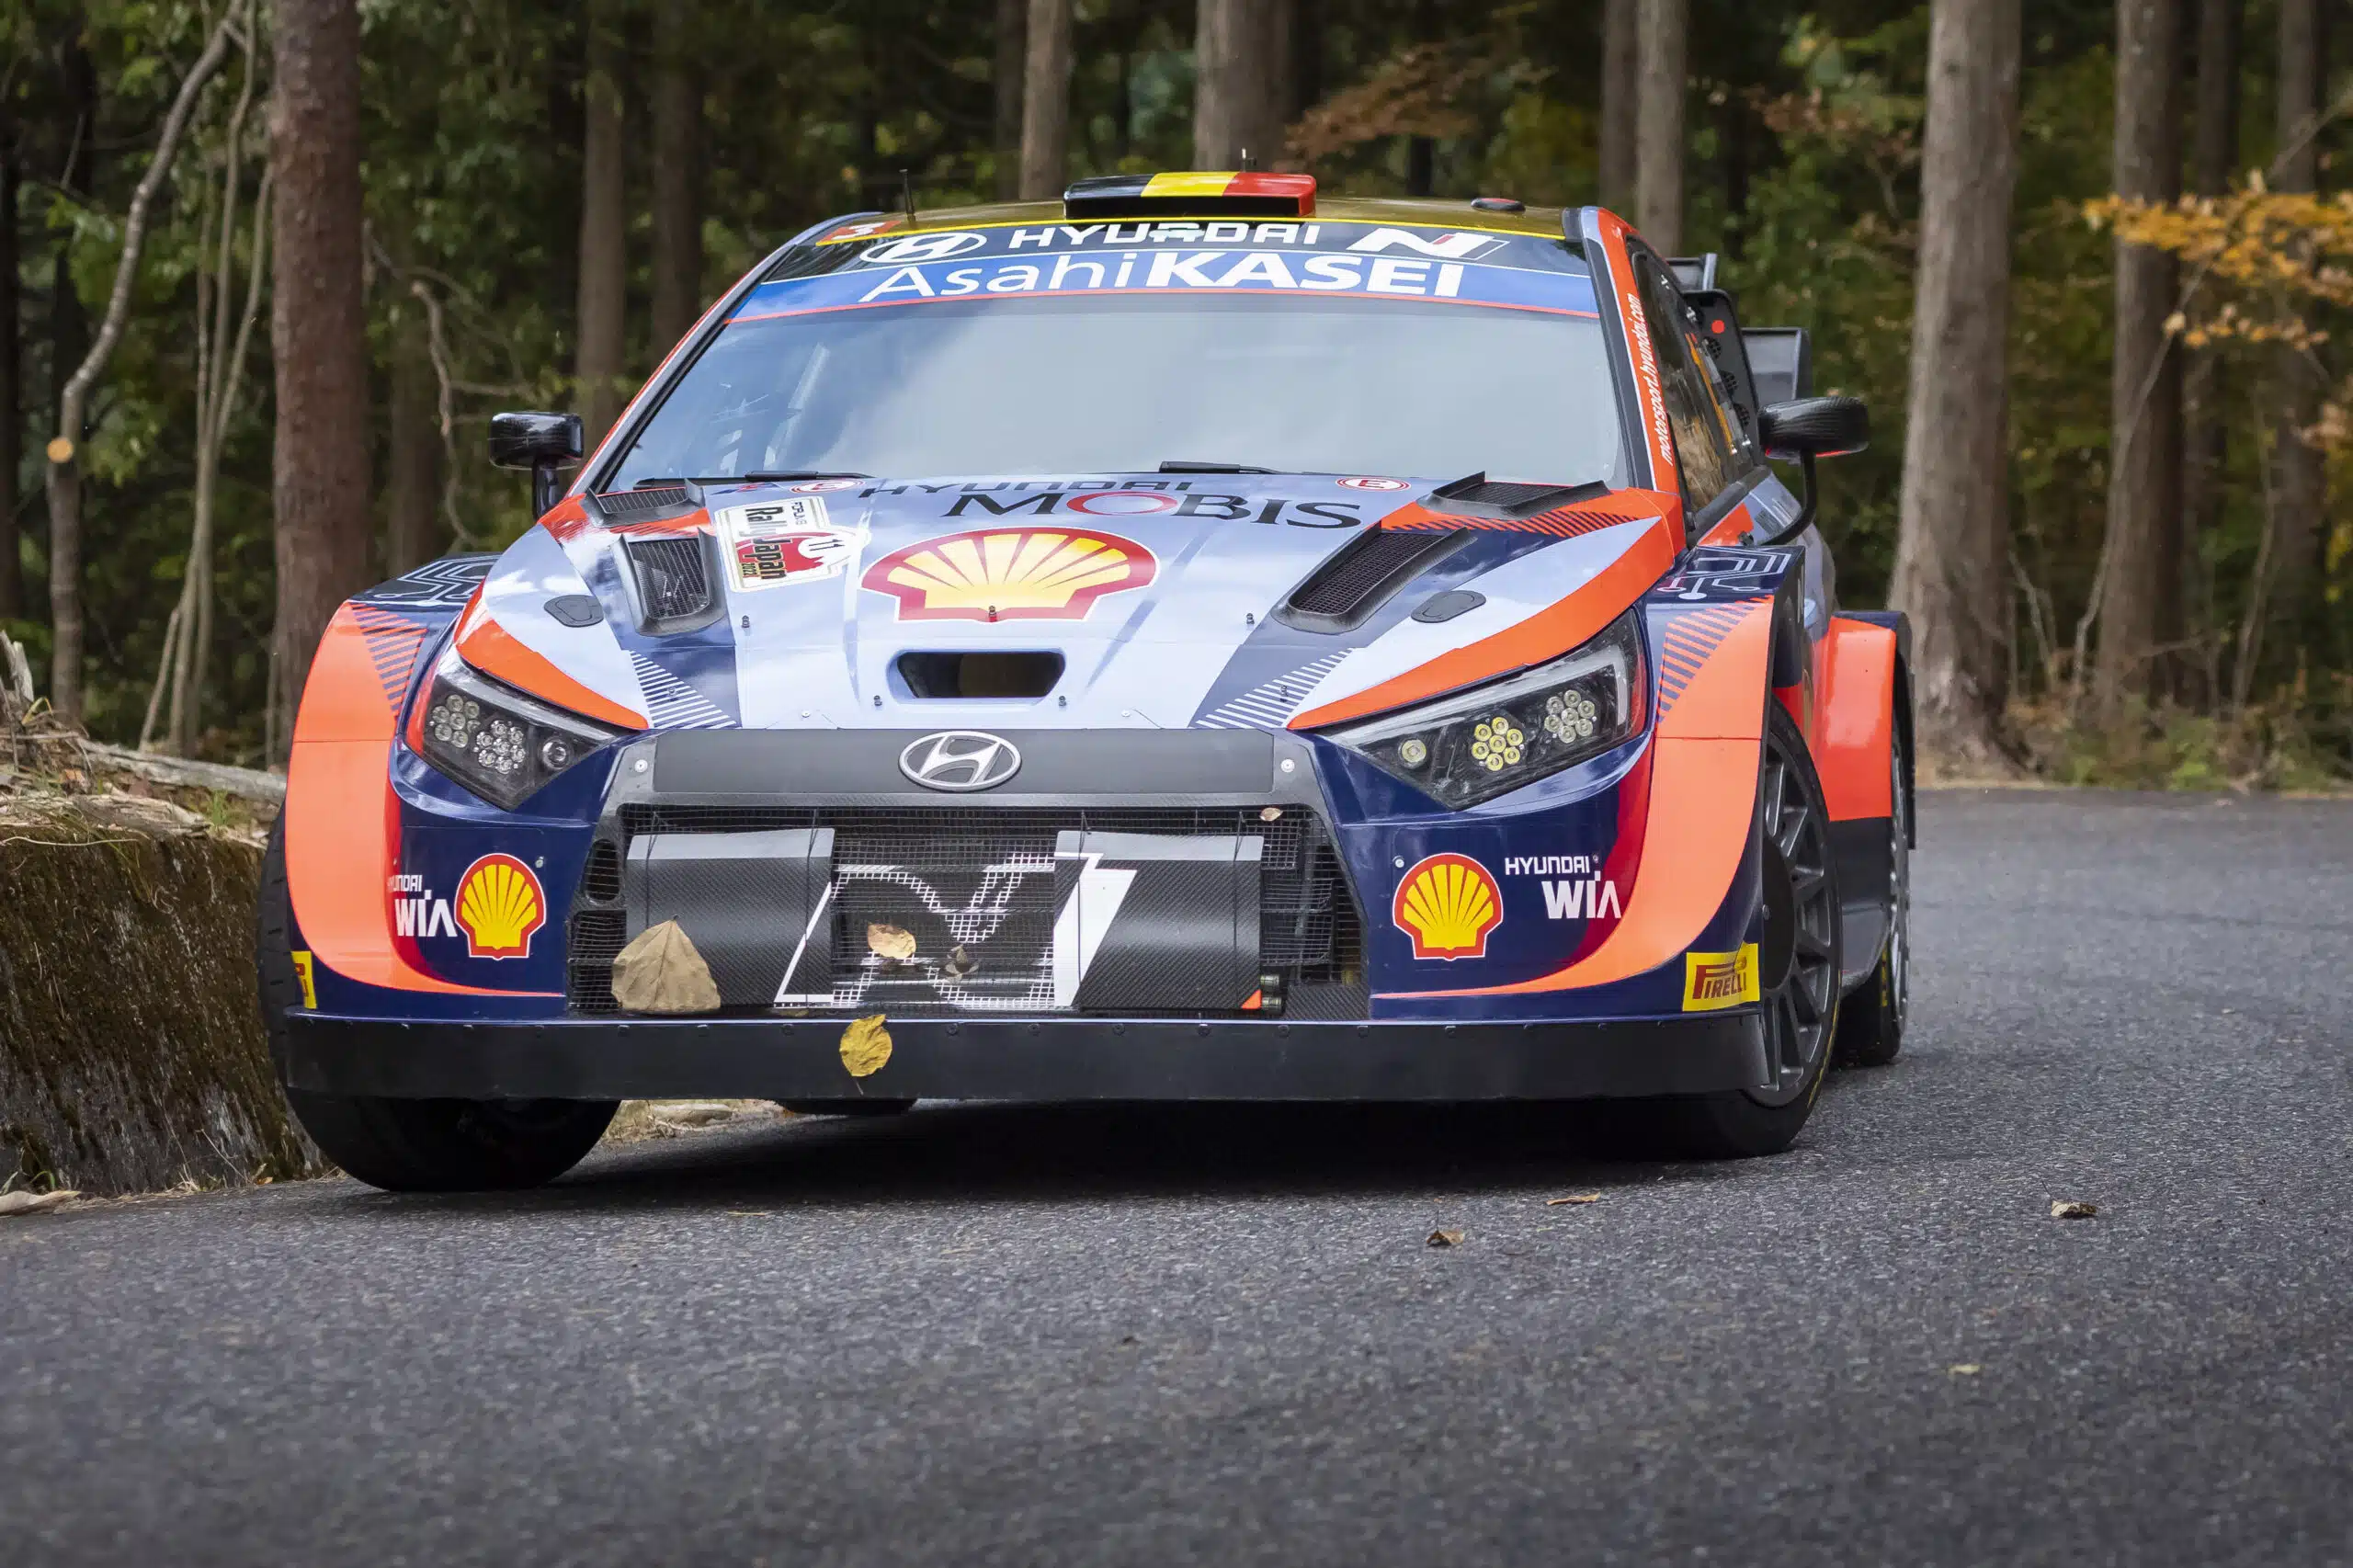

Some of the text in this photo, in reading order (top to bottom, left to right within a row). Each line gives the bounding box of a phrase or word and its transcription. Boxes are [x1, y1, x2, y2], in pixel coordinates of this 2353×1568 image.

[1007, 222, 1322, 248] HYUNDAI
[1627, 292, 1674, 466] motorsport.hyundai.com
[858, 481, 1194, 498] HYUNDAI
[940, 490, 1362, 528] MOBIS
[738, 506, 793, 580] Rally Japan
[809, 539, 847, 552] 11
[741, 562, 756, 578] 2022
[1504, 856, 1590, 875] HYUNDAI
[1692, 955, 1748, 1000] PIRELLI
